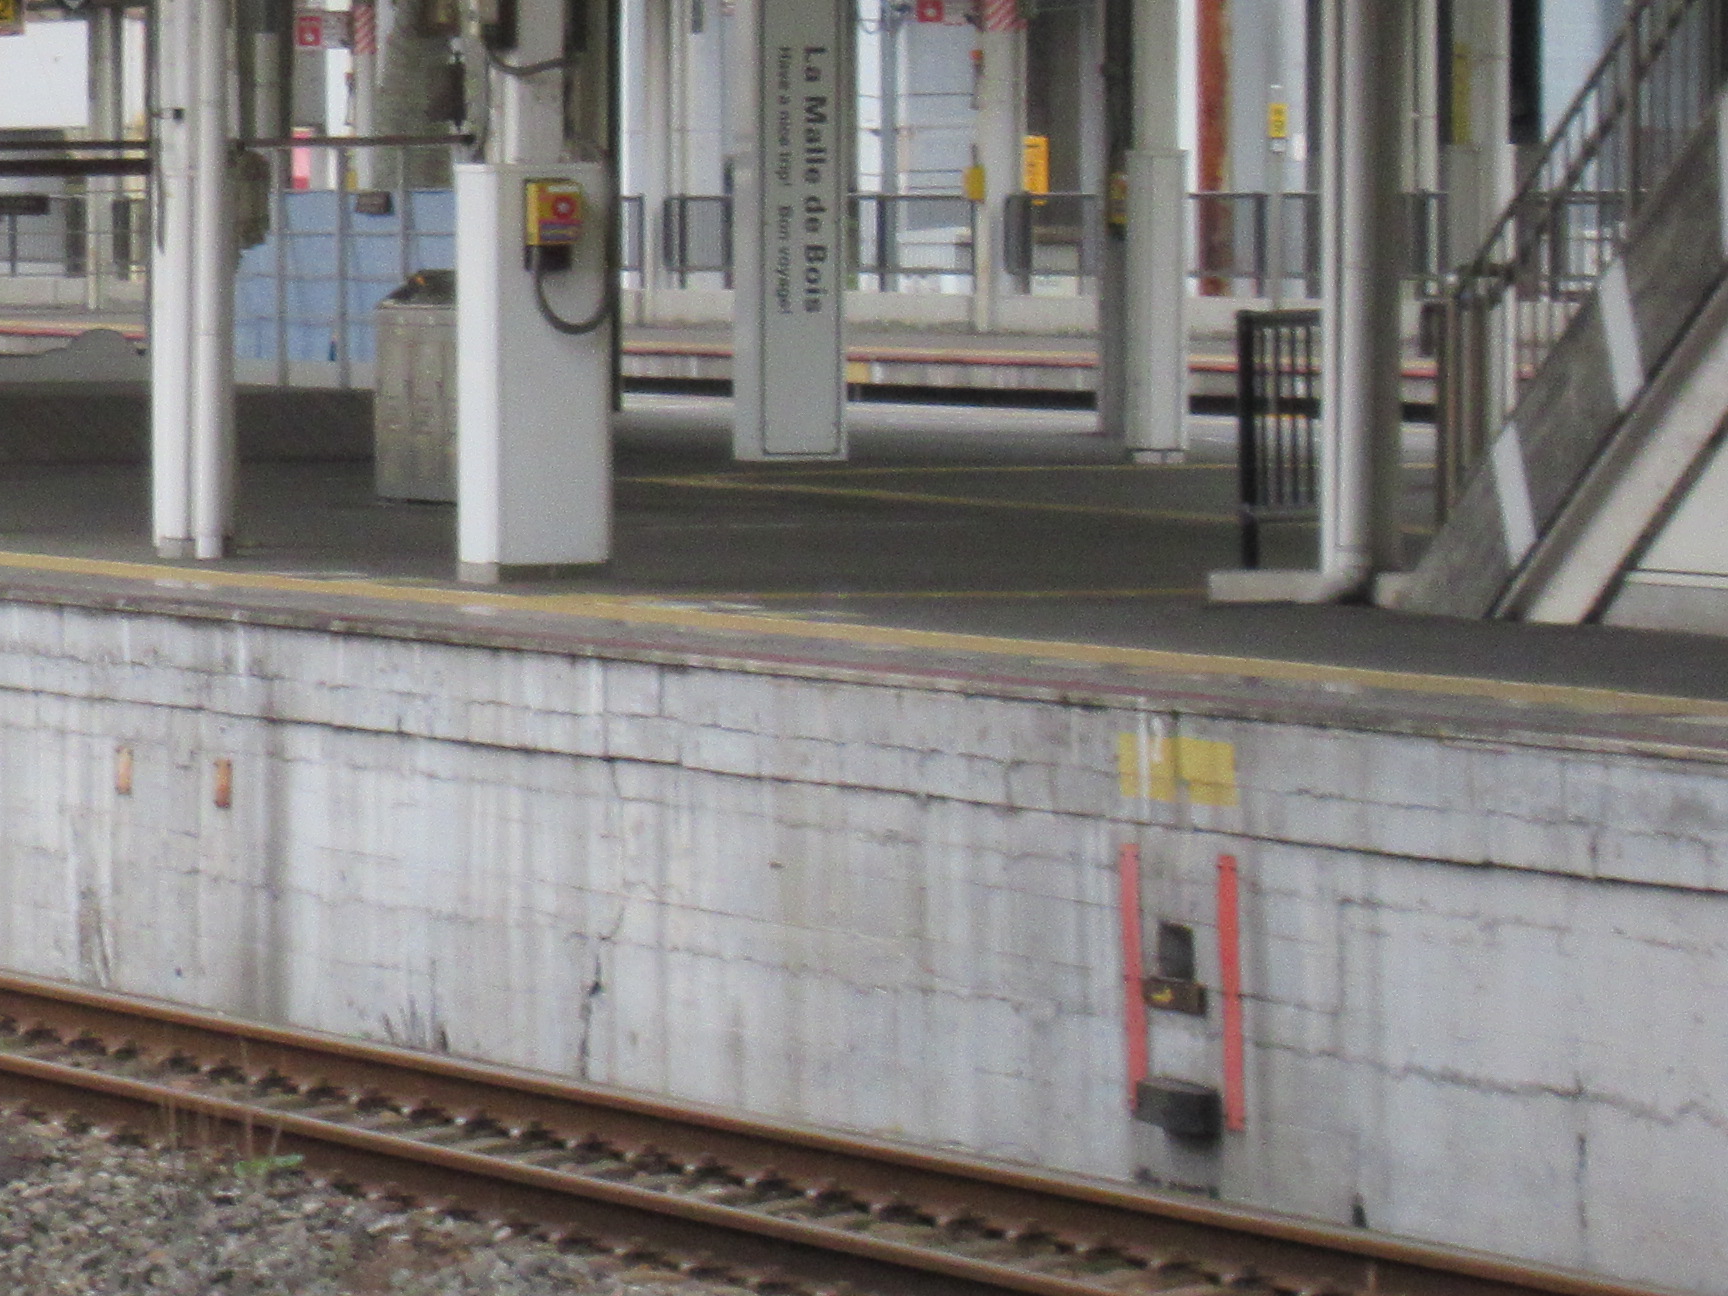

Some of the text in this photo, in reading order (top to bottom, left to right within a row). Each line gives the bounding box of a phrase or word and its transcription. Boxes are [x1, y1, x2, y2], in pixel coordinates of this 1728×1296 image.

[803, 46, 828, 313] La Malle de Bois
